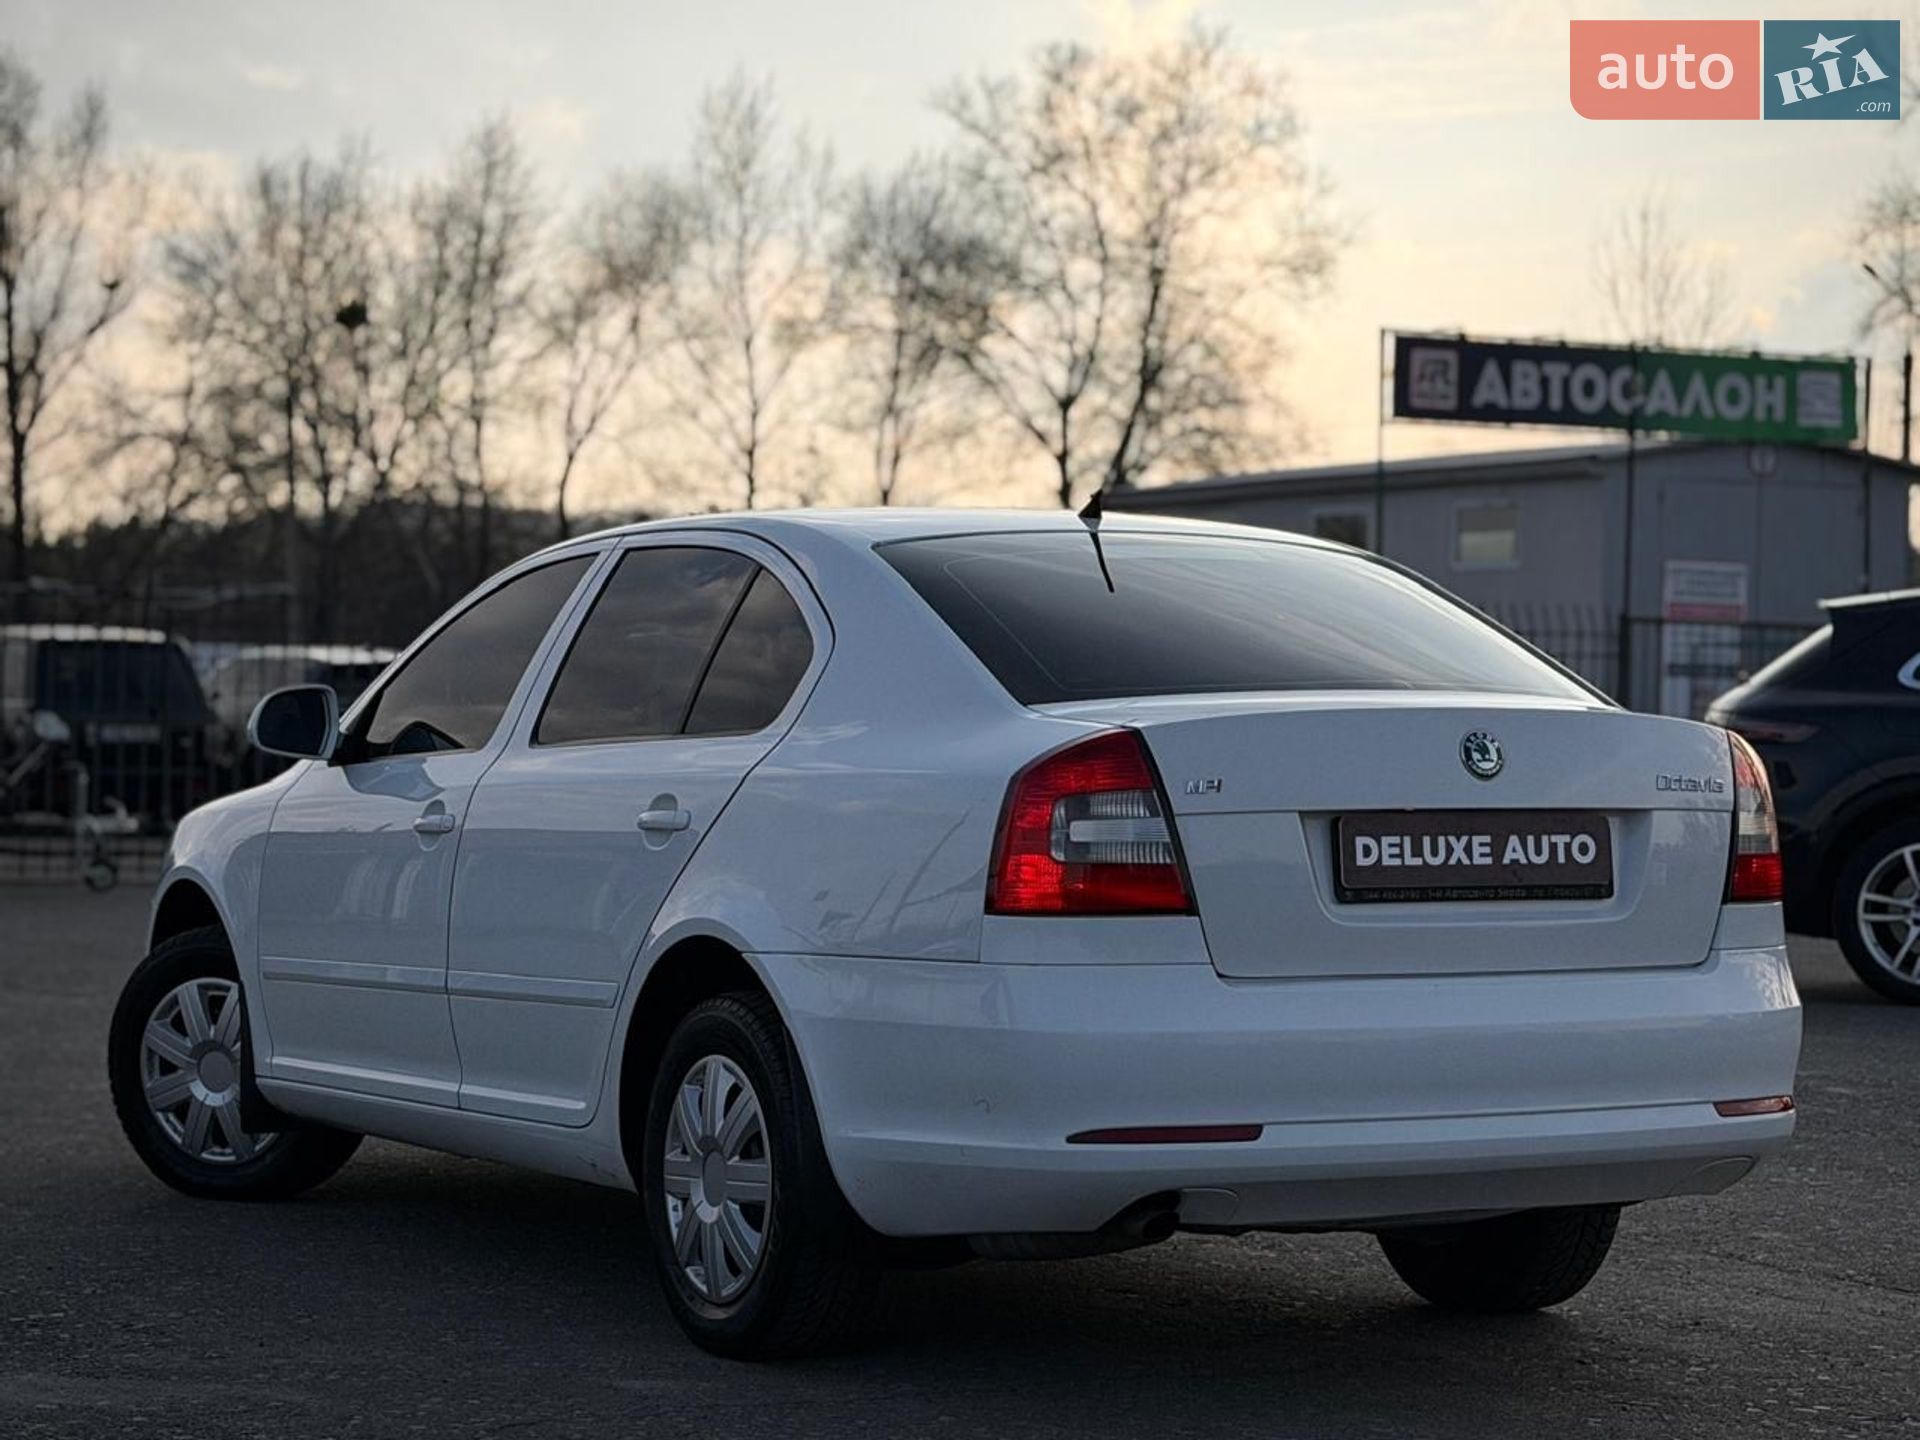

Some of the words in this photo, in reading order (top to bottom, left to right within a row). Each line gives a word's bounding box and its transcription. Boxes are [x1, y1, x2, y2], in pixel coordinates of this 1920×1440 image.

[1471, 358, 1786, 422] АВТОСАЛОН
[1656, 774, 1724, 793] Octavia
[1354, 835, 1494, 867] DELUXE
[1501, 833, 1597, 865] AUTO
